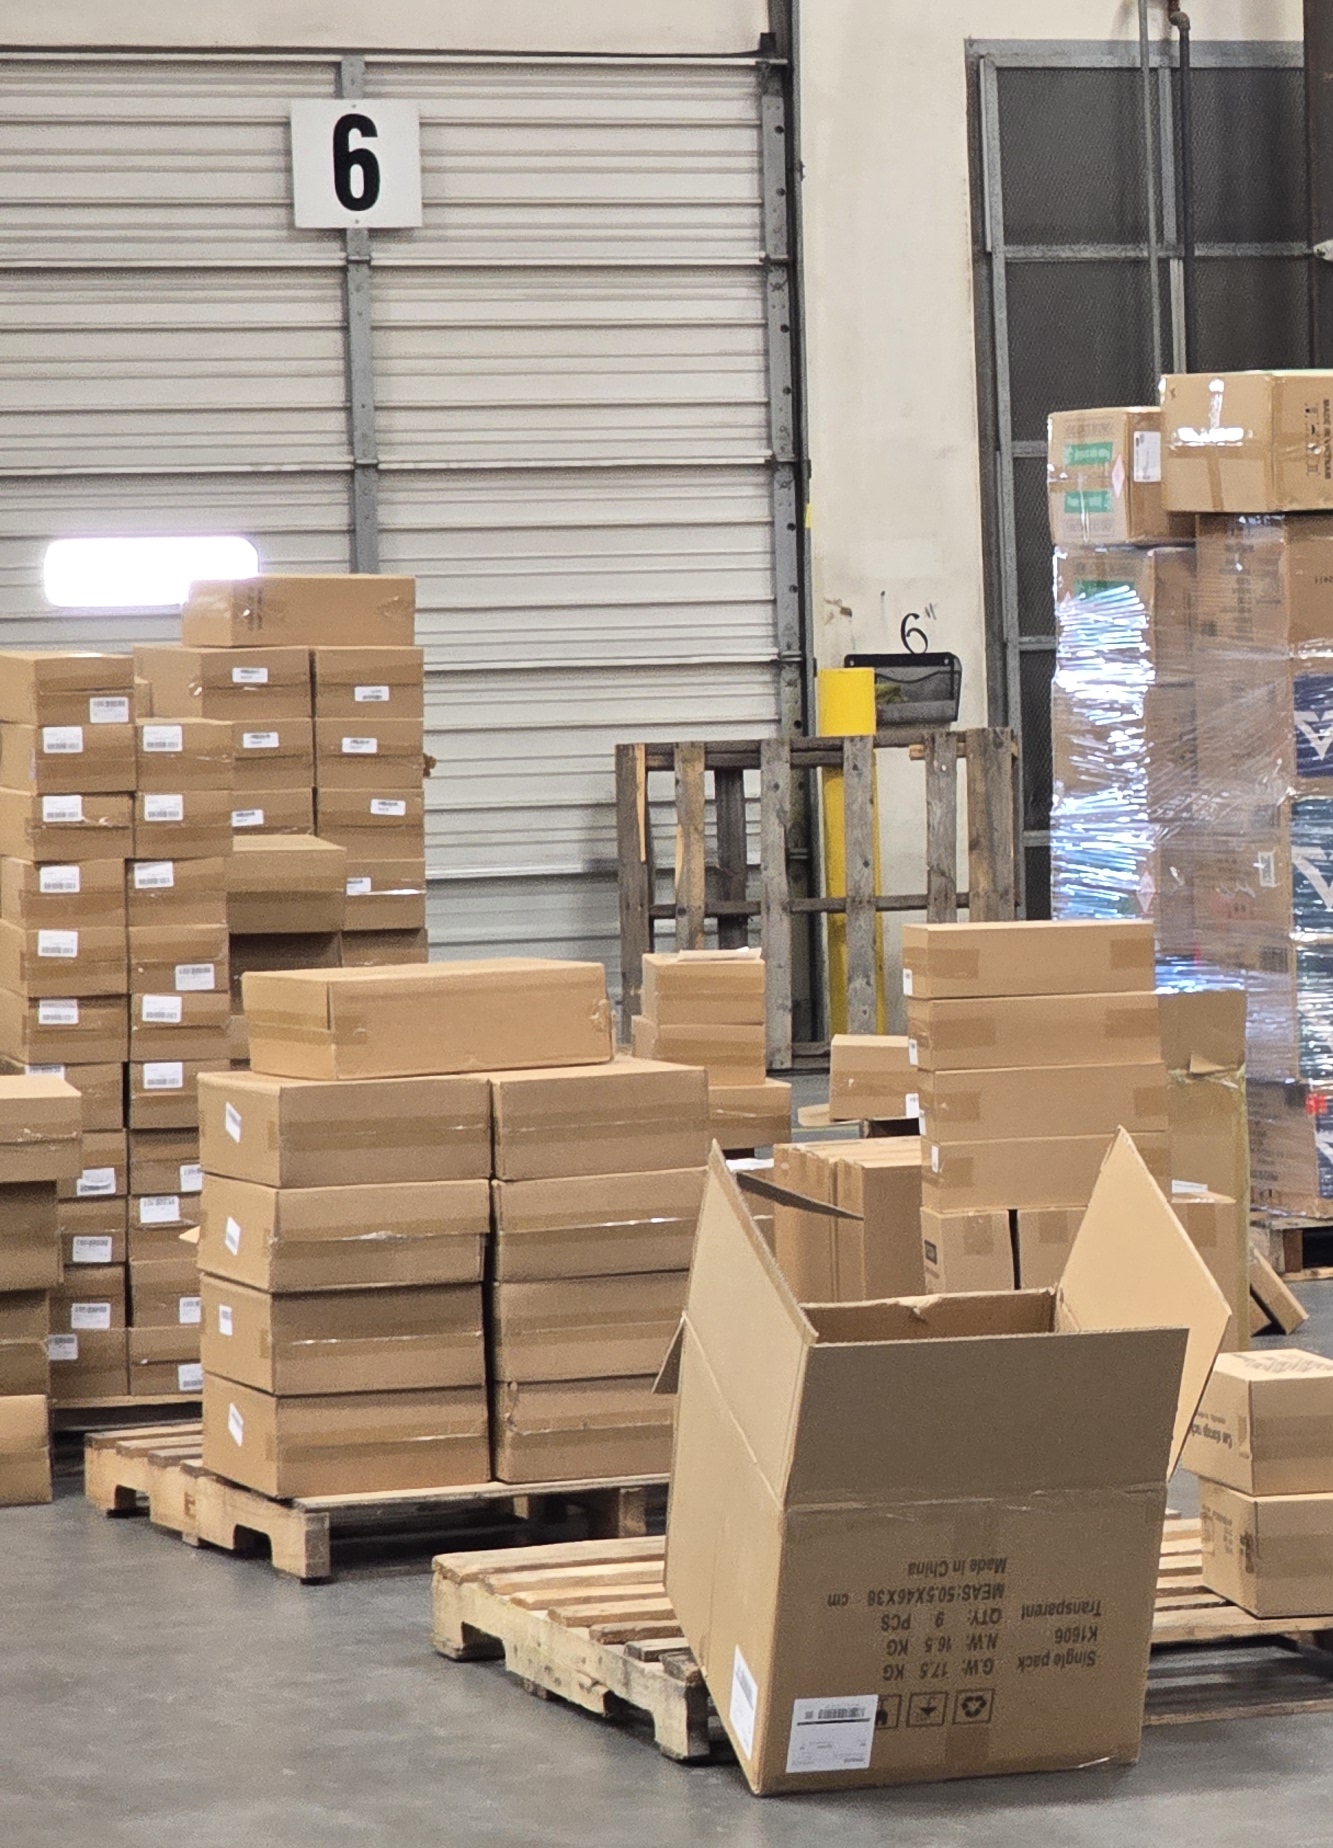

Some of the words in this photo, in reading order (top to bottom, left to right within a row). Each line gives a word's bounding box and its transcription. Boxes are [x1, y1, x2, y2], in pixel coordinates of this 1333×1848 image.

[332, 113, 381, 212] 6
[900, 612, 929, 654] 6
[907, 1559, 948, 1578] China
[952, 1559, 966, 1574] in
[970, 1557, 1007, 1575] Made
[827, 1593, 849, 1608] cm
[1020, 1600, 1102, 1621] Transparent
[880, 1612, 912, 1632] PCS
[1054, 1626, 1099, 1645] K1606
[885, 1638, 909, 1657] KG
[1017, 1654, 1050, 1673] pack
[1053, 1649, 1097, 1670] Single
[882, 1663, 905, 1682] KG
